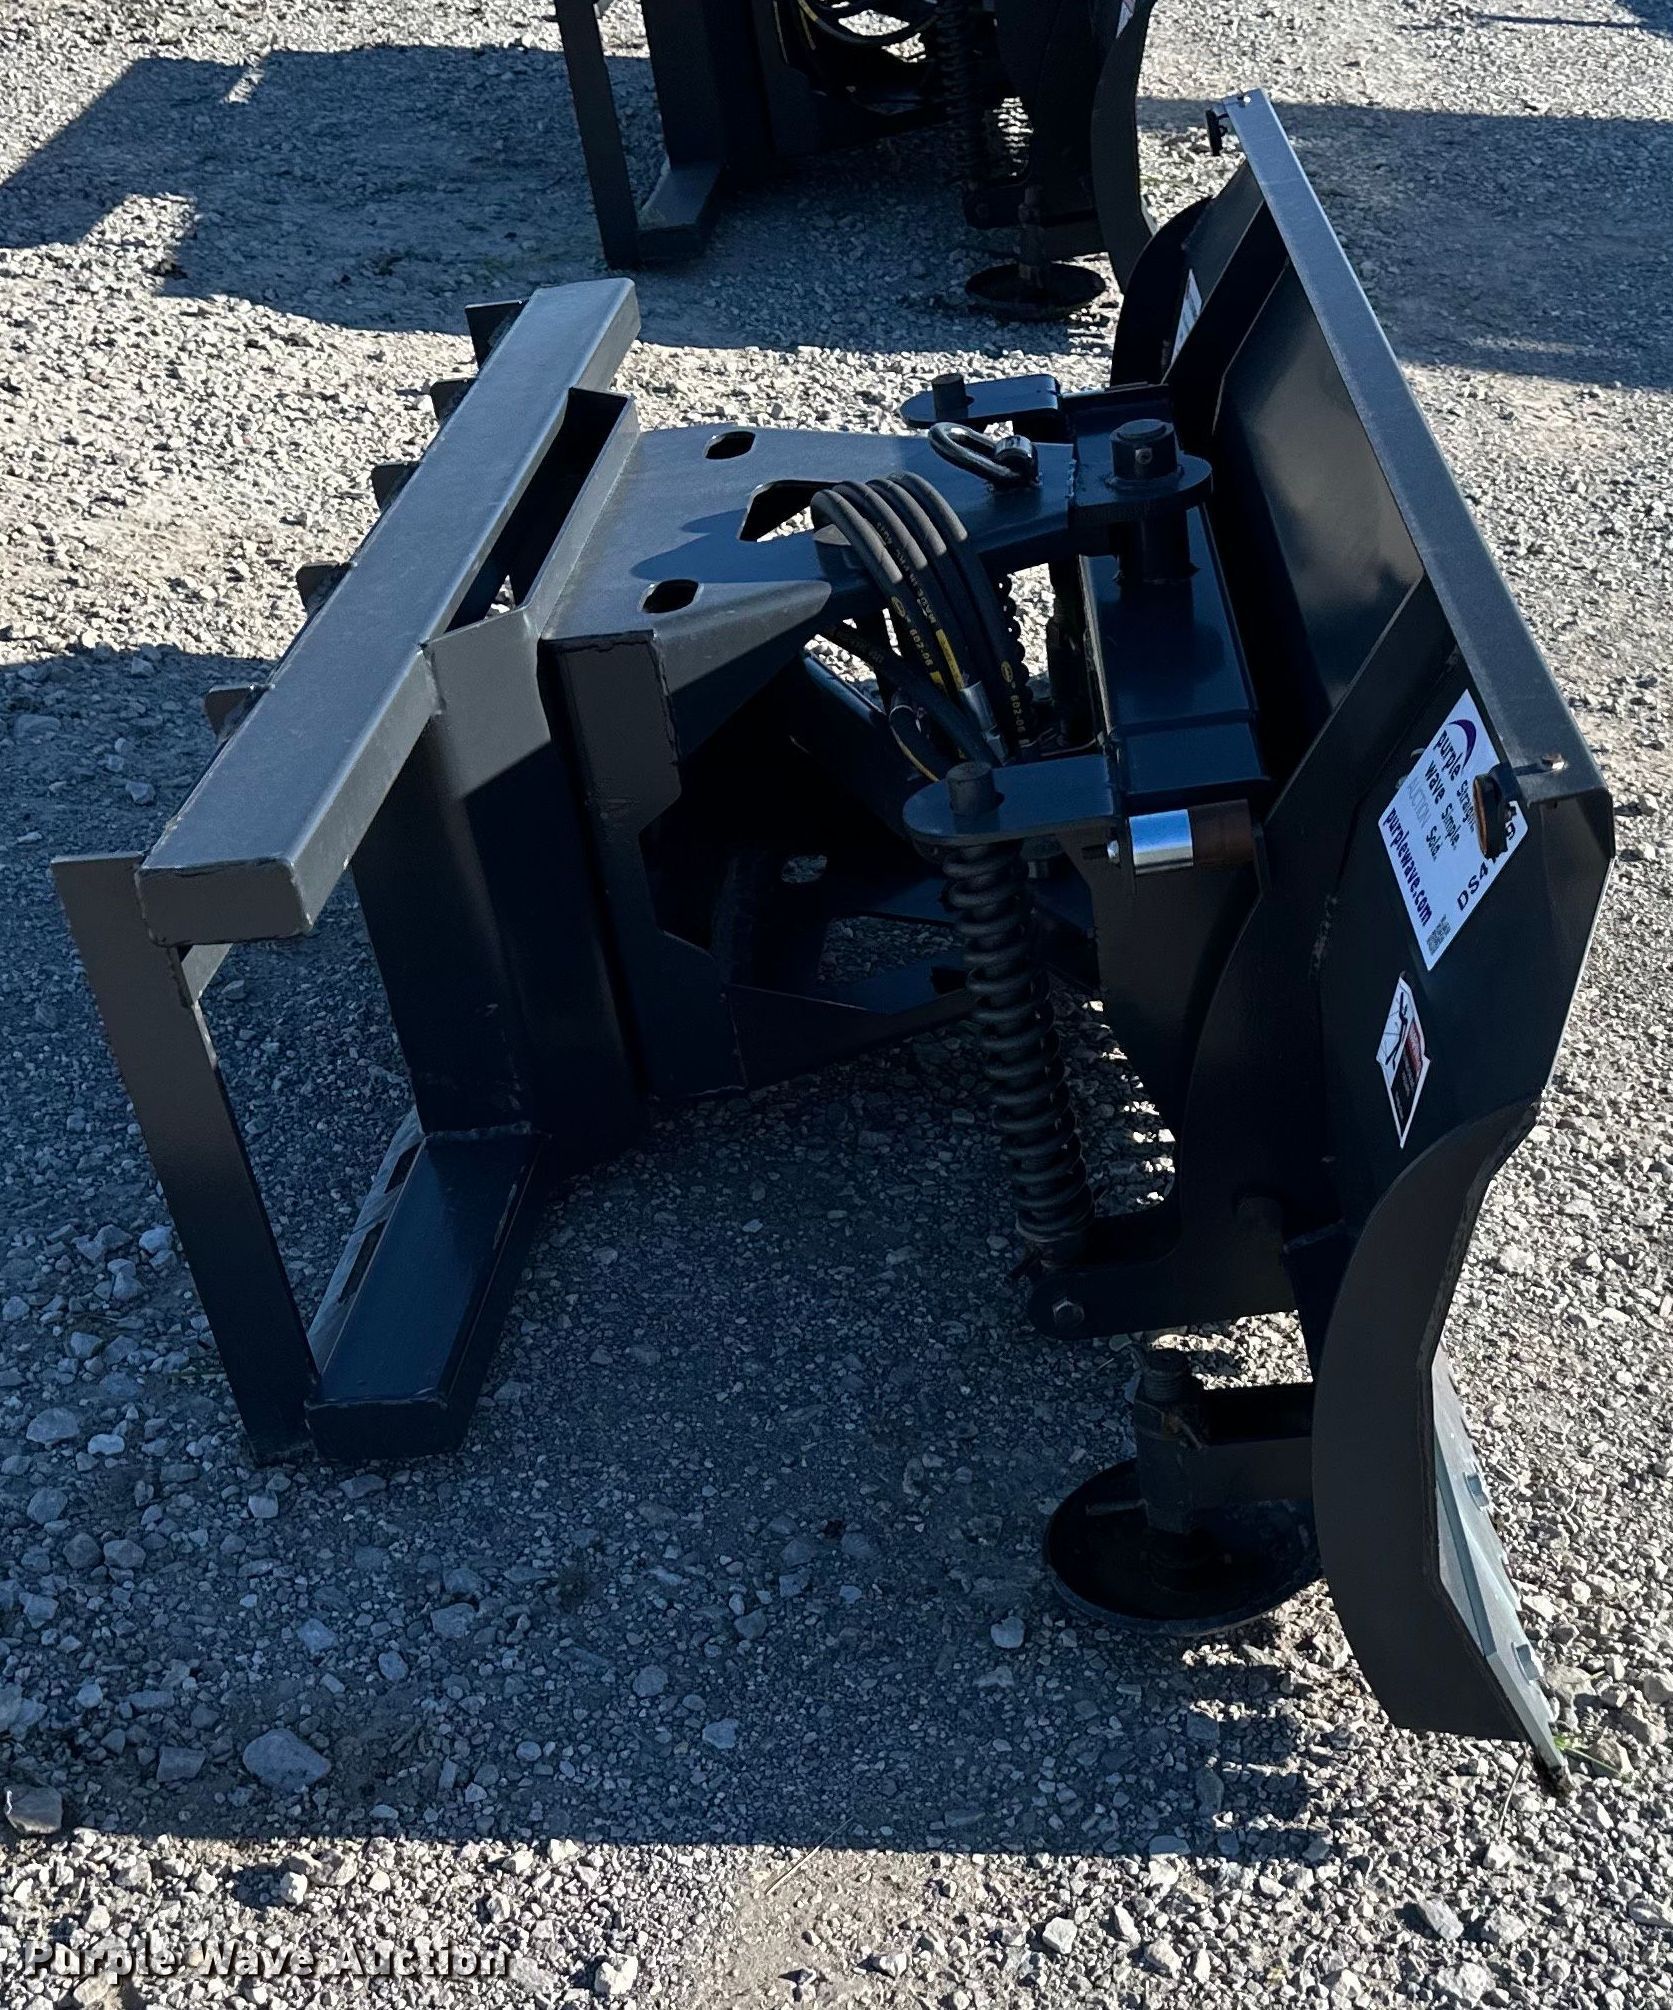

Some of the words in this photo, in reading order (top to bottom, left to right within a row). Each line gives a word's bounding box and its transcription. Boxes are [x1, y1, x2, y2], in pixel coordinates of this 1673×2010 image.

[1433, 729, 1463, 781] purple
[1407, 777, 1432, 829] AUCTION
[1424, 760, 1446, 805] wave
[1382, 807, 1433, 927] purplewave.com
